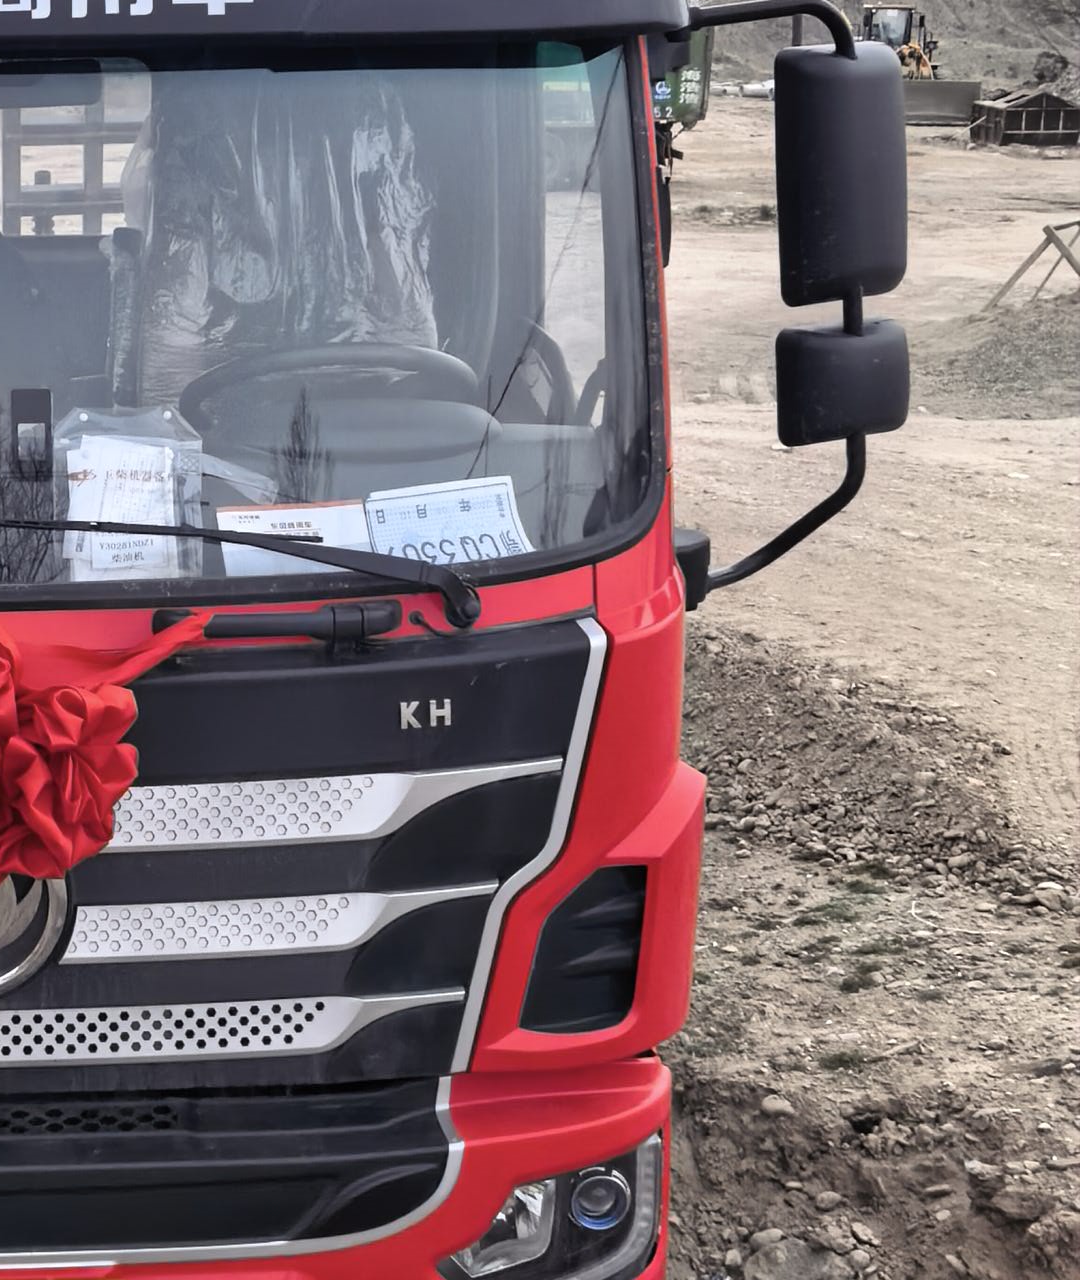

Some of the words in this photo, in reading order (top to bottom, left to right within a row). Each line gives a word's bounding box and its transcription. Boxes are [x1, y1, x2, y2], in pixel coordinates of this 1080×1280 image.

[376, 509, 386, 524] 日
[416, 504, 427, 518] 月
[400, 699, 452, 729] KH
